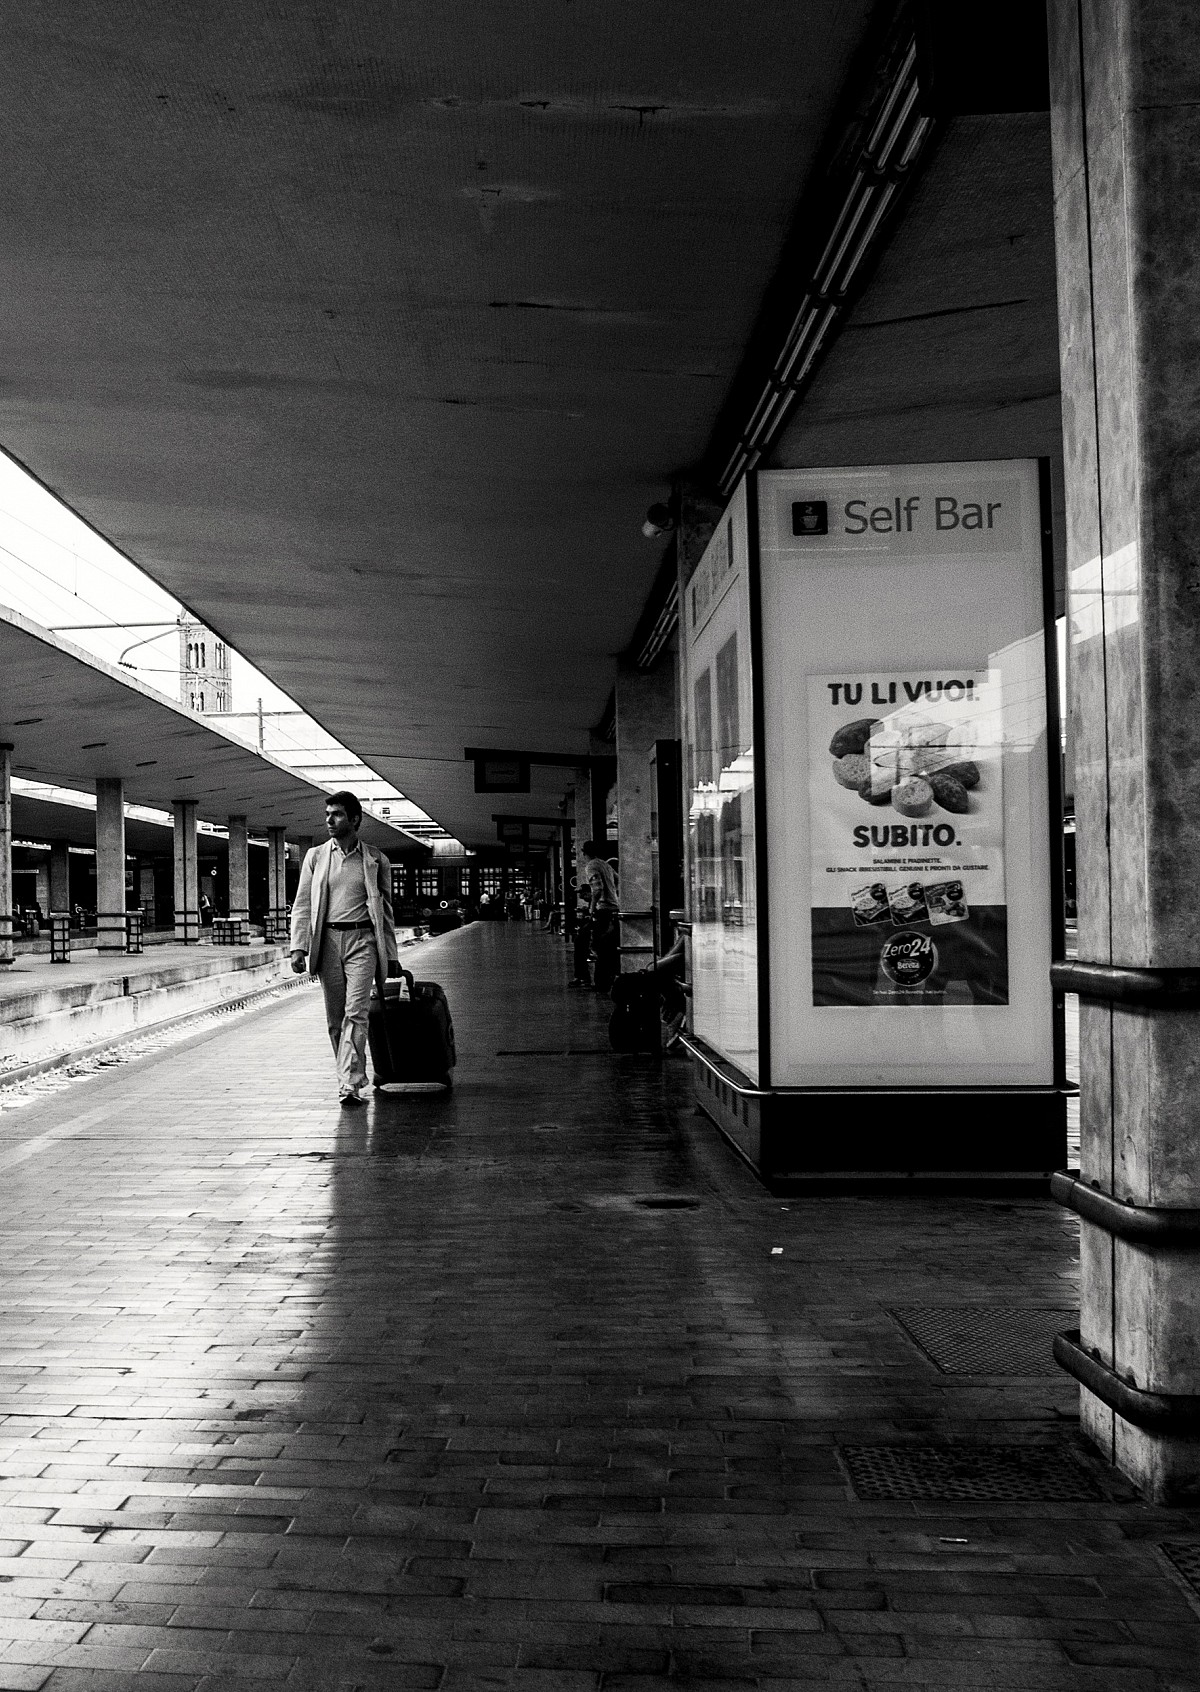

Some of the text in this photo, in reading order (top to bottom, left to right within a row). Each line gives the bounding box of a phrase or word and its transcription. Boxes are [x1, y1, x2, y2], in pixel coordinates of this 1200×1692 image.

[844, 496, 1002, 534] Self Bar
[827, 679, 980, 705] TU LI VUOI.
[852, 823, 962, 848] SUBITO.
[882, 936, 932, 958] Zero24
